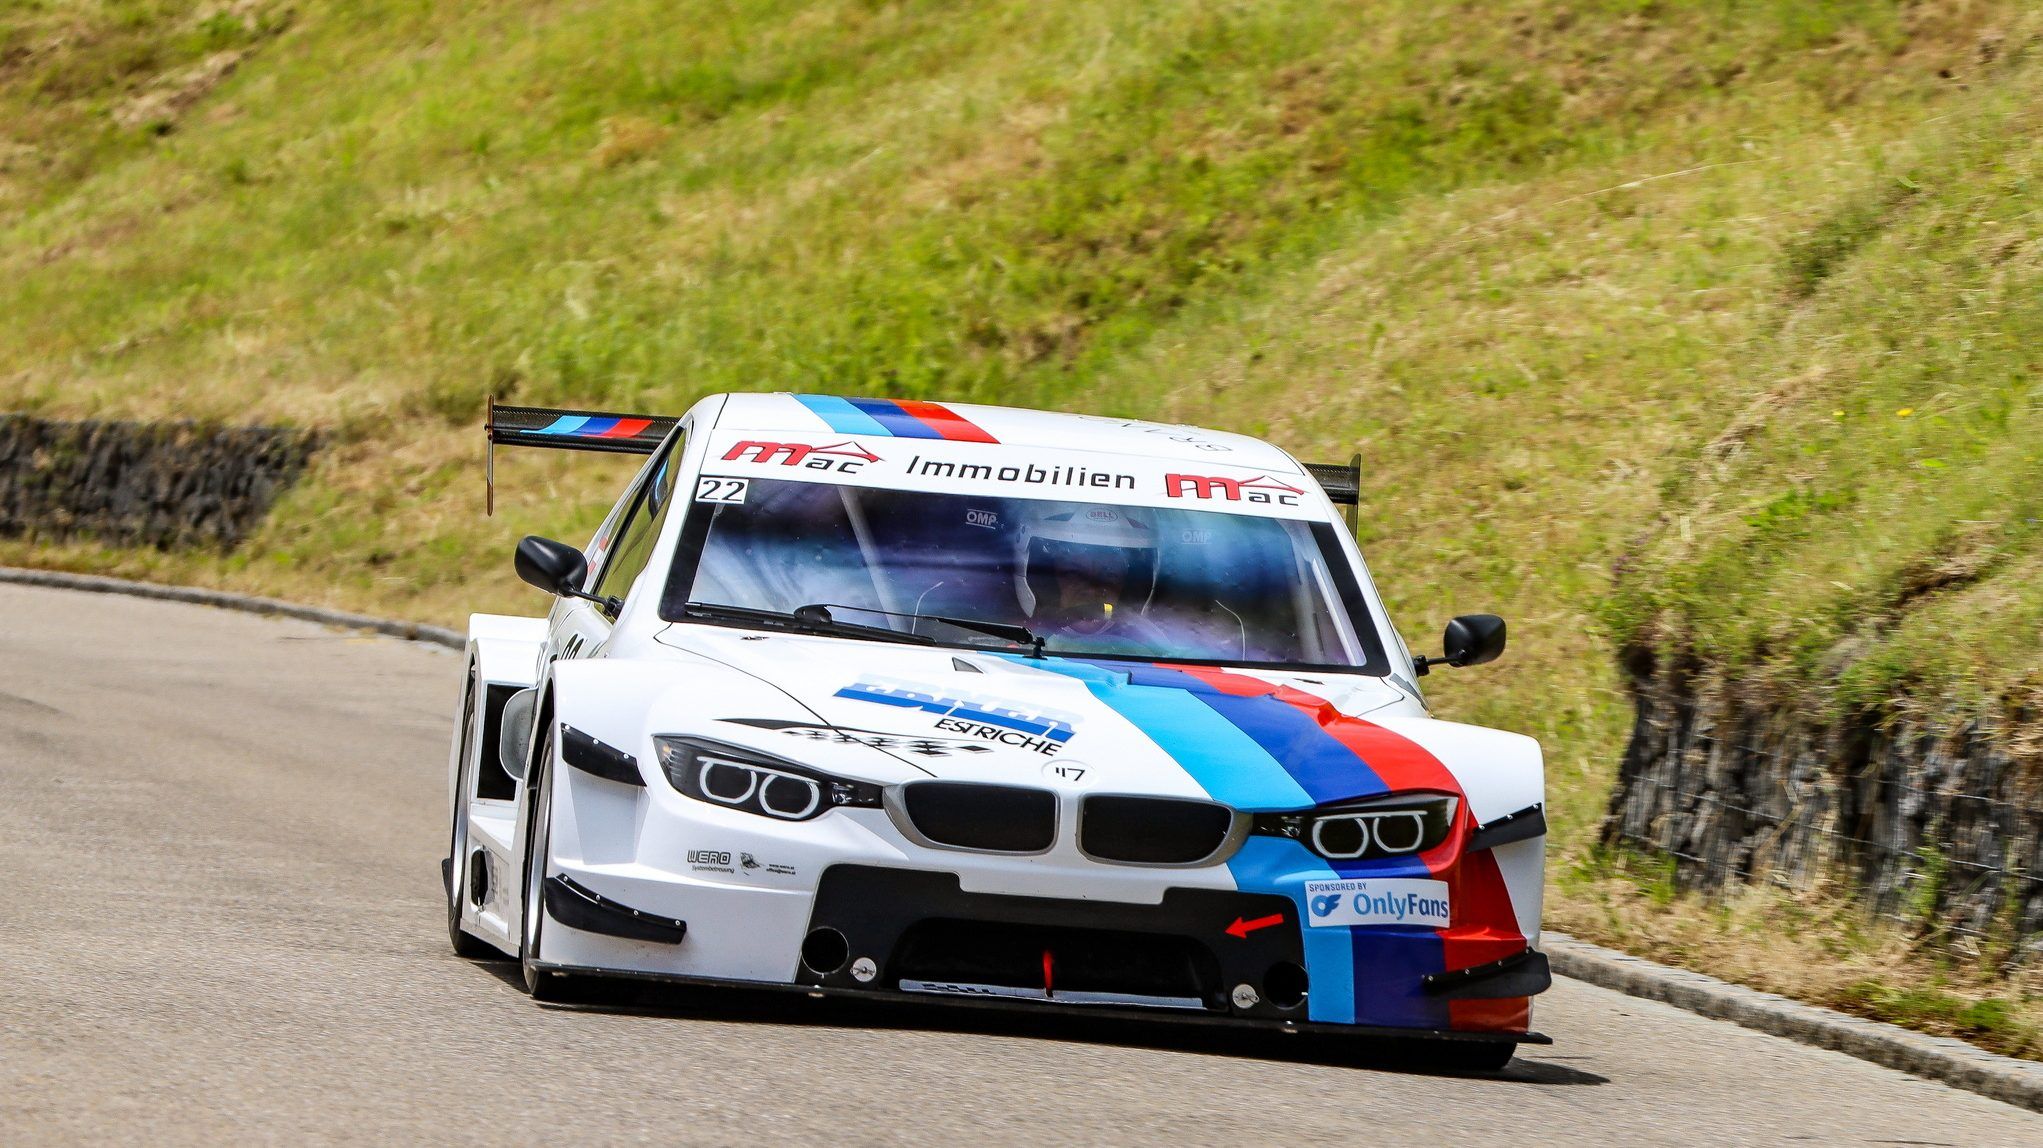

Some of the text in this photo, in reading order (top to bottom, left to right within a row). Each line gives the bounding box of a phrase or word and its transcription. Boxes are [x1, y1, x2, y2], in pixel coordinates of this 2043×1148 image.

[905, 455, 1136, 490] Immobilien
[698, 479, 746, 502] 22
[966, 511, 997, 526] OMP
[933, 718, 1063, 757] ESTRICHE
[687, 849, 731, 865] WERO
[1308, 882, 1367, 892] SPONSORED BY
[1353, 891, 1449, 920] OnlyFans
